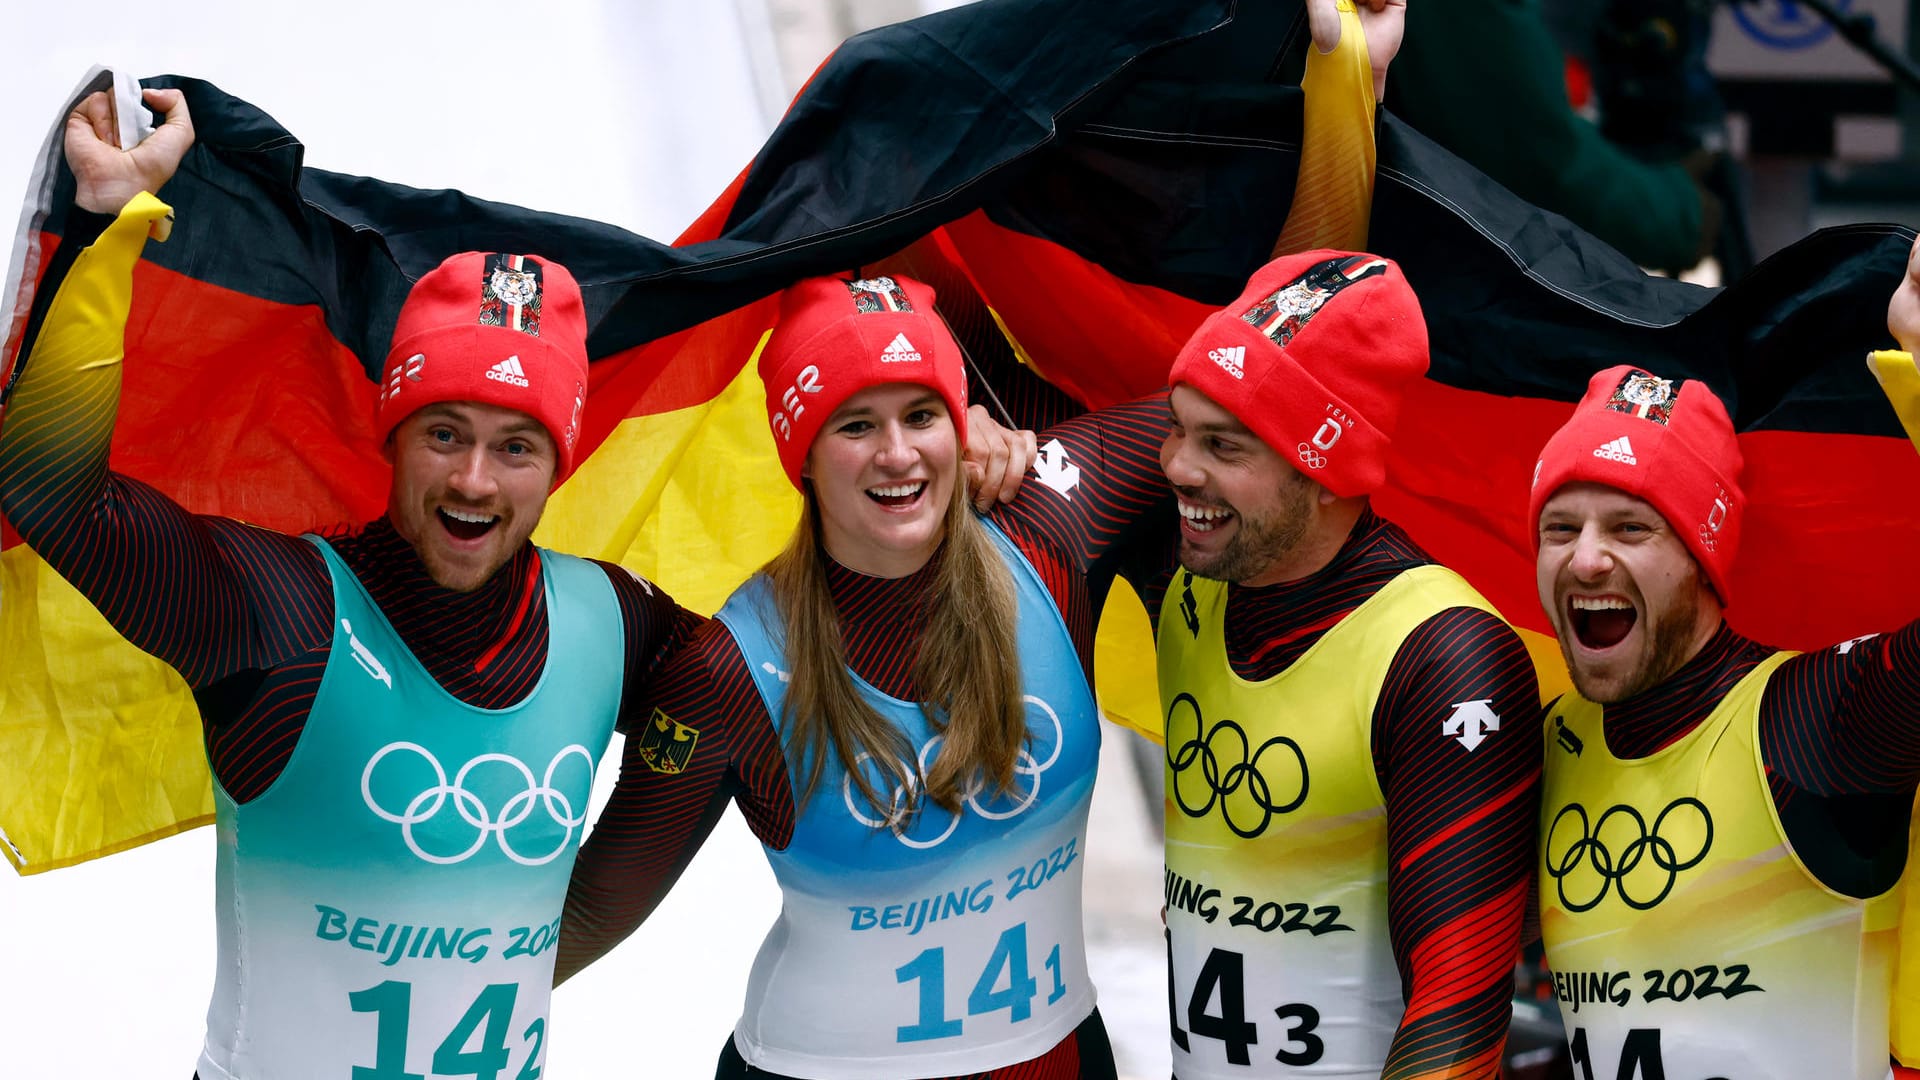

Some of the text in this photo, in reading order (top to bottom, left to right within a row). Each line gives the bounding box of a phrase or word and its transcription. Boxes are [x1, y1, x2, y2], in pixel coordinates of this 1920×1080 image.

[485, 370, 529, 387] adidas
[880, 351, 922, 362] adidas
[1208, 350, 1244, 380] adidas
[772, 365, 824, 442] GER
[1326, 402, 1355, 429] TEAM
[1312, 417, 1342, 450] D
[1593, 449, 1637, 465] adidas
[848, 837, 1078, 935] BEIJING 2022
[1165, 868, 1356, 936] IJING 2022
[315, 904, 560, 966] BEIJING 202
[895, 922, 1066, 1043] 14 1
[1643, 964, 1766, 1004] 2022
[348, 980, 545, 1080] 14 2
[1274, 1003, 1324, 1066] 3
